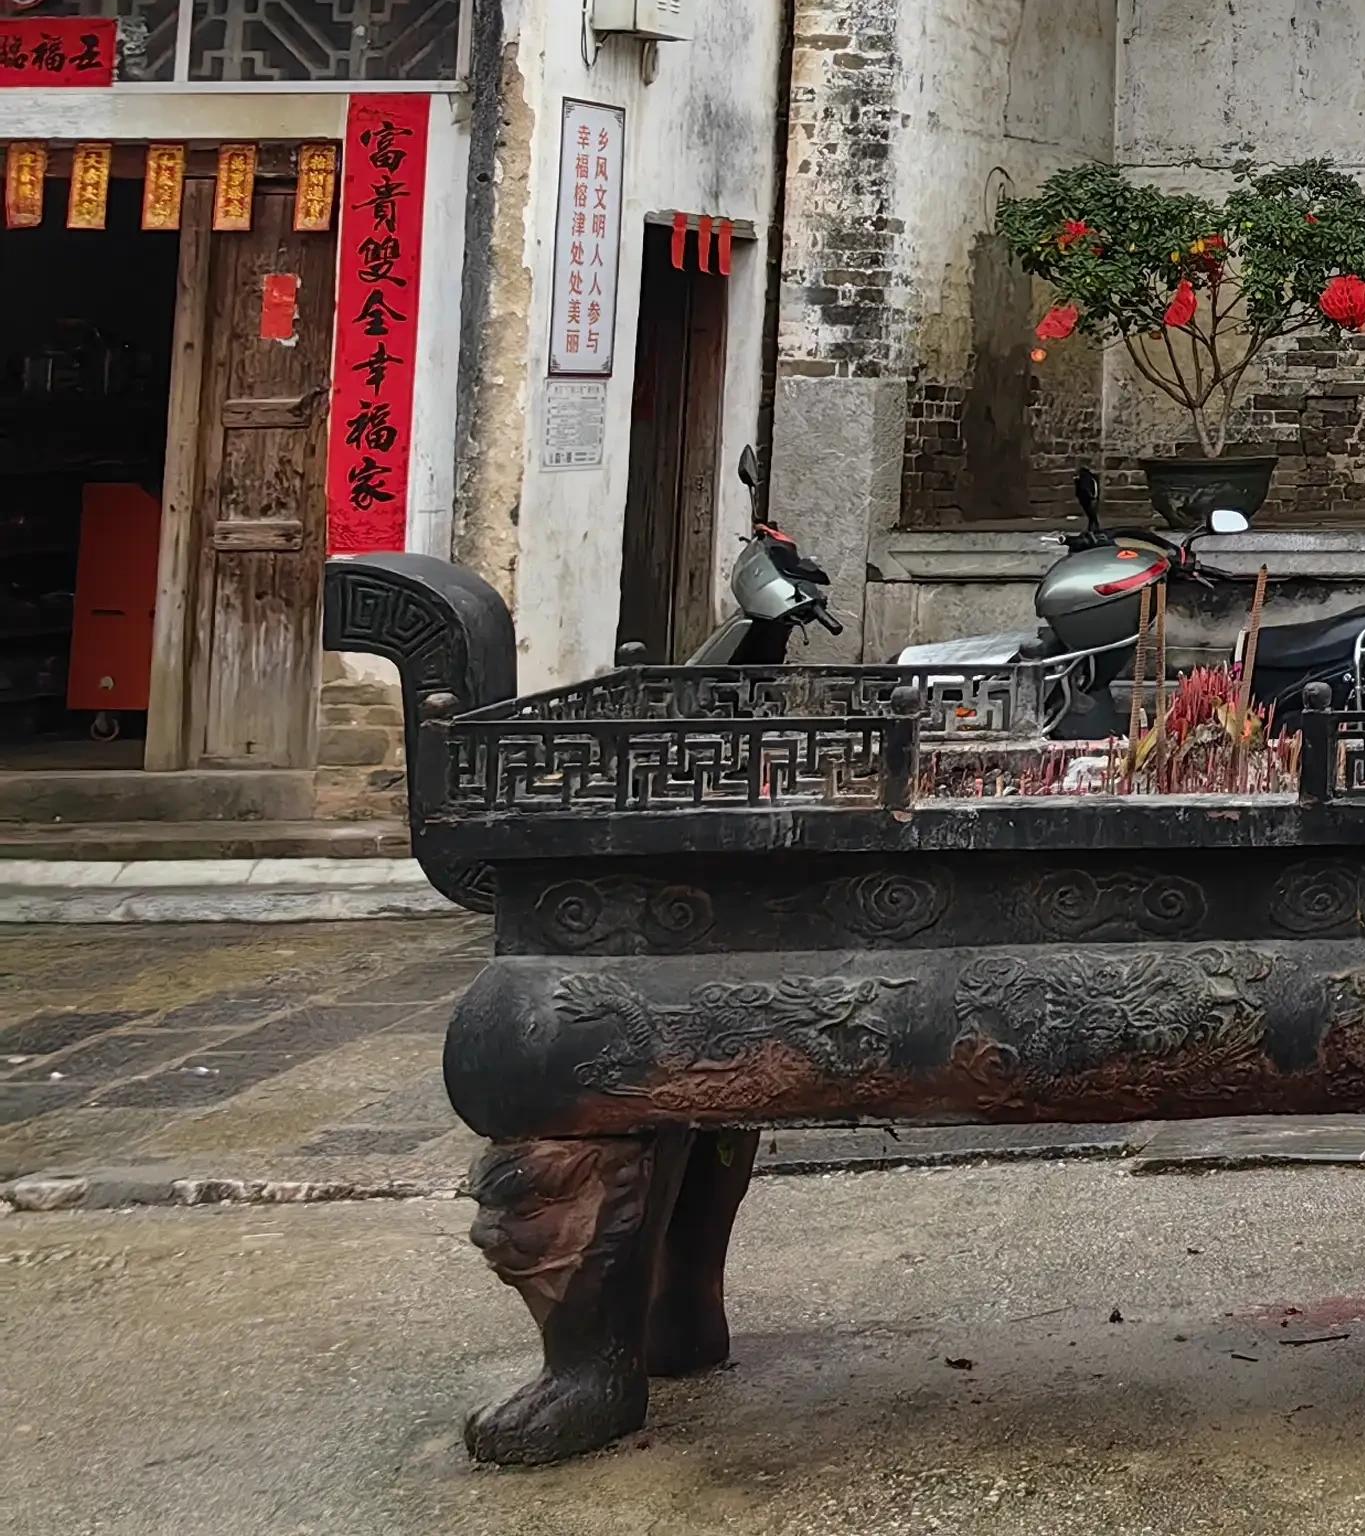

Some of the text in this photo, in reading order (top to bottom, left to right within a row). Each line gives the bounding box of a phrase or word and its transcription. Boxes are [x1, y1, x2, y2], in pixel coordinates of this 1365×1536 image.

[566, 125, 591, 354] 幸福榕津处处美丽
[586, 127, 609, 354] 乡风文明人人参与
